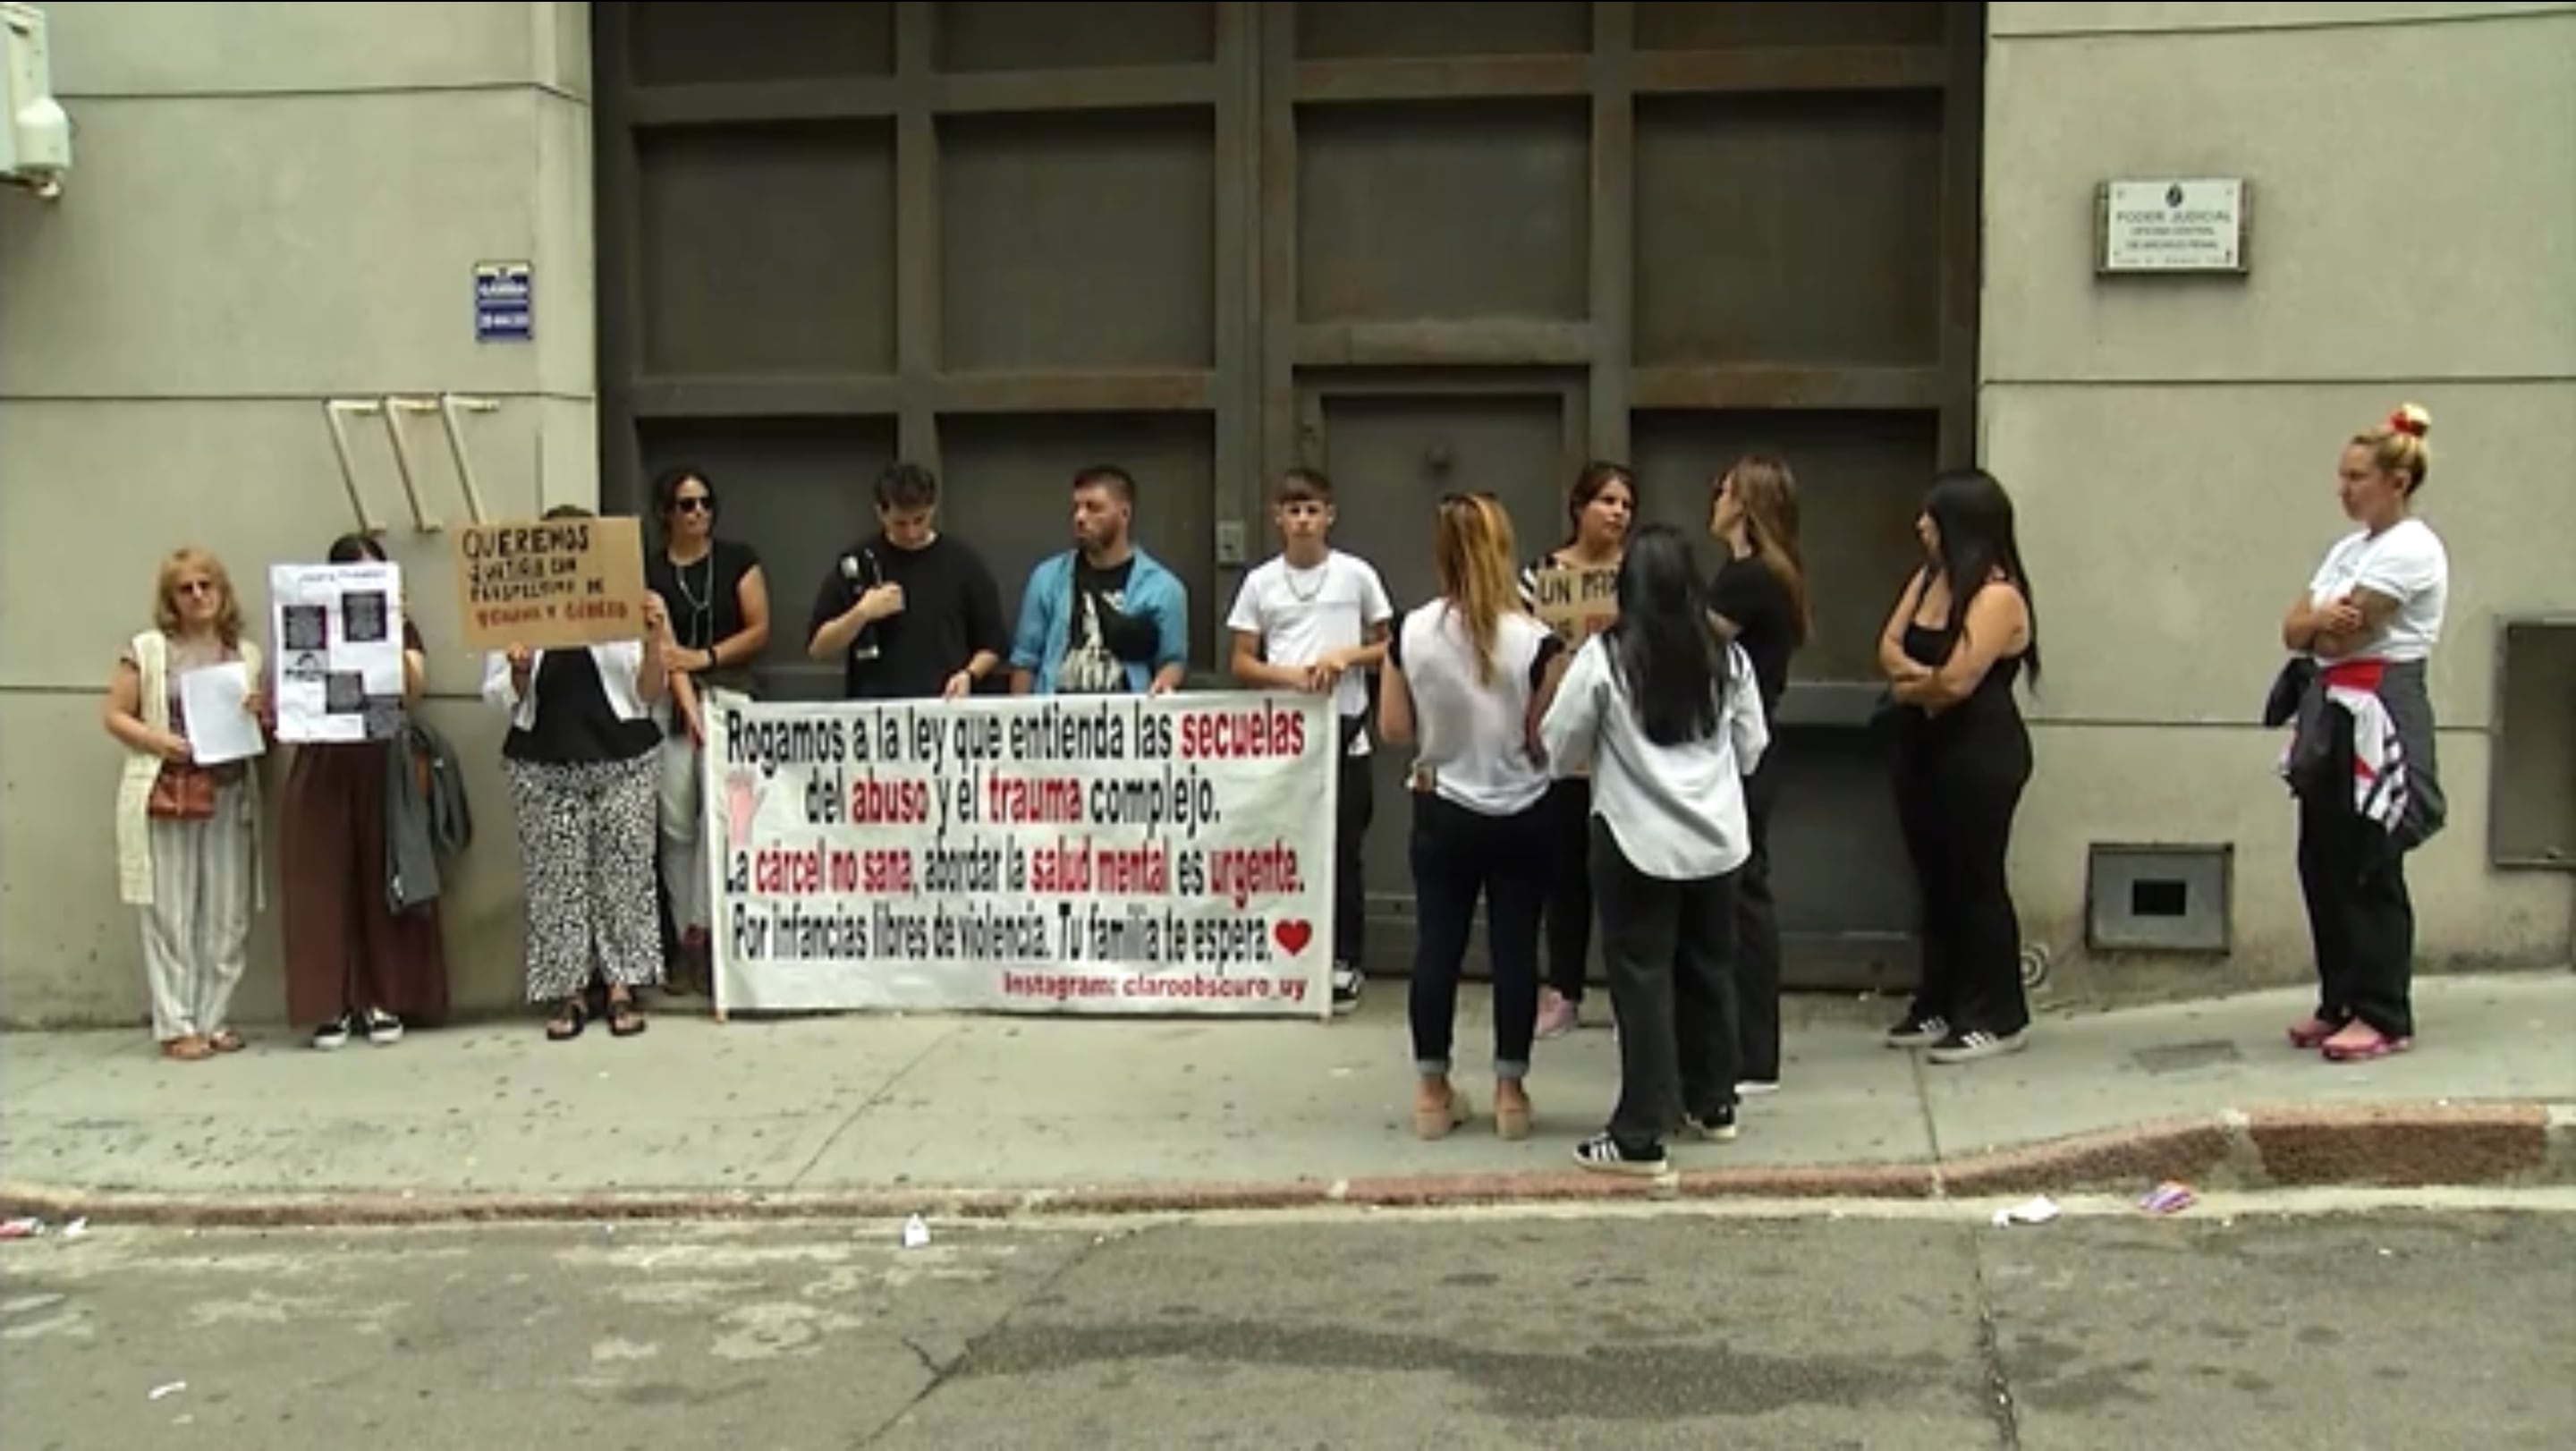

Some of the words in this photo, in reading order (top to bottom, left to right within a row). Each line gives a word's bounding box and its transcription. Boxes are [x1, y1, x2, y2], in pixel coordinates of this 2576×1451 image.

[2116, 211, 2165, 223] PODER
[2172, 210, 2232, 224] JUDICIAL
[462, 524, 589, 559] QUEREMOS
[1540, 576, 1571, 604] UN
[727, 710, 844, 777] Rogamos
[852, 718, 868, 761] a
[877, 707, 899, 760] la
[909, 707, 946, 775] ley
[953, 717, 1002, 773] que
[1011, 700, 1123, 759] entienda
[1134, 700, 1172, 759] las
[1181, 698, 1304, 758] secuelas
[806, 767, 844, 824] del
[852, 767, 929, 824] abuso
[936, 777, 951, 836] y
[957, 765, 979, 824] el
[988, 768, 1082, 824] trauma
[1089, 763, 1221, 839] complejo.
[724, 836, 749, 893] La
[756, 837, 826, 893] cárcel
[831, 850, 858, 893] no
[863, 850, 919, 900] sana,
[925, 834, 1002, 893] abordar
[1006, 834, 1024, 893] la
[1030, 835, 1091, 893] salud
[1097, 835, 1172, 893] mental
[1178, 850, 1204, 895] es
[1210, 837, 1304, 910] urgente.
[733, 902, 767, 961] Por
[773, 902, 866, 961] infancias
[873, 902, 927, 961] libres
[934, 902, 954, 959] de
[960, 901, 1051, 961] violencia.
[1058, 903, 1082, 961] Tu
[1089, 902, 1159, 962] familia
[1165, 905, 1187, 962] te
[1193, 917, 1272, 976] espera.
[1004, 972, 1116, 1001] Instagram:
[1123, 972, 1307, 1001] claroobscuro_uy
